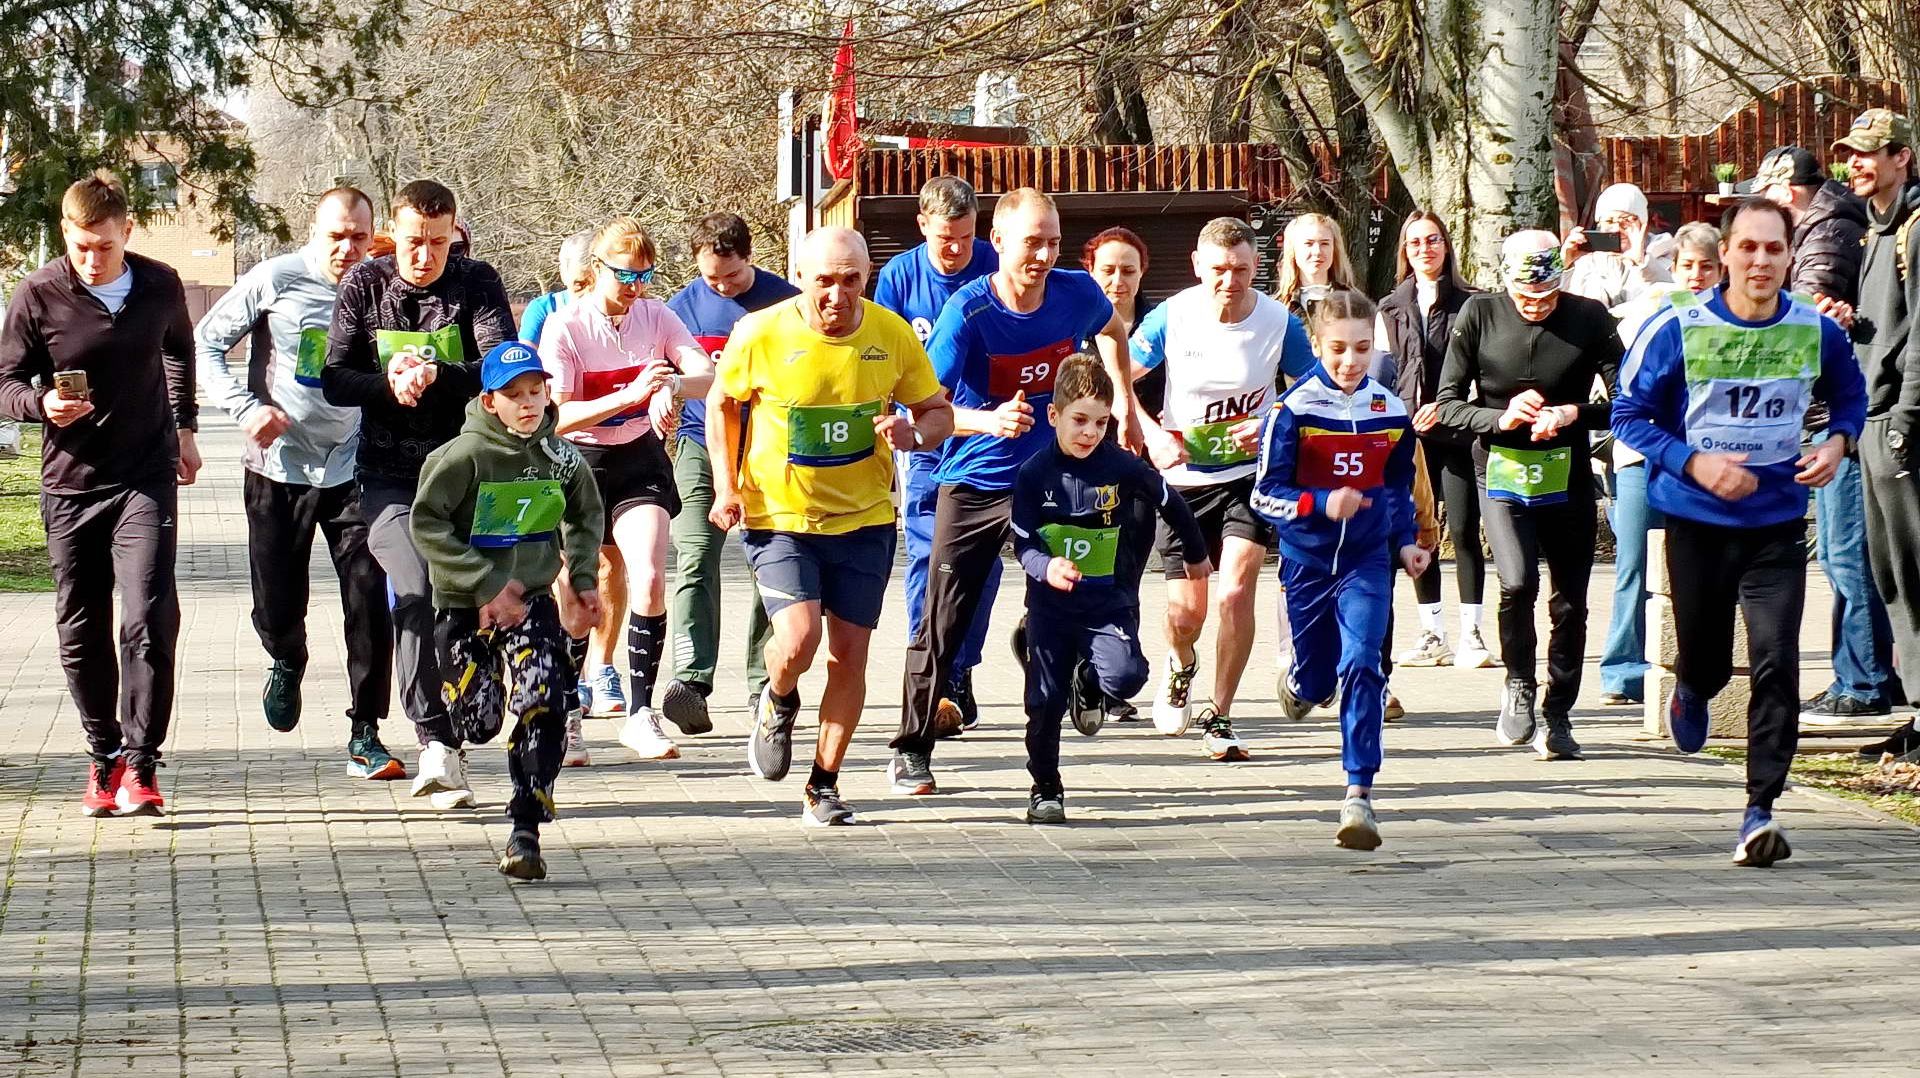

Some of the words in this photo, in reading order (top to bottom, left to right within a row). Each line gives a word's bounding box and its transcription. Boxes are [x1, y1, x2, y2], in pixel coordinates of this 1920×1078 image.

[1020, 363, 1050, 384] 59
[1725, 386, 1761, 418] 12
[1764, 398, 1785, 418] 13
[821, 421, 849, 443] 18
[1208, 436, 1236, 455] 23
[1714, 440, 1763, 452] РОСАТОМ
[1333, 452, 1364, 476] 55
[1514, 464, 1543, 484] 33
[517, 499, 532, 522] 7
[1064, 537, 1092, 560] 19
